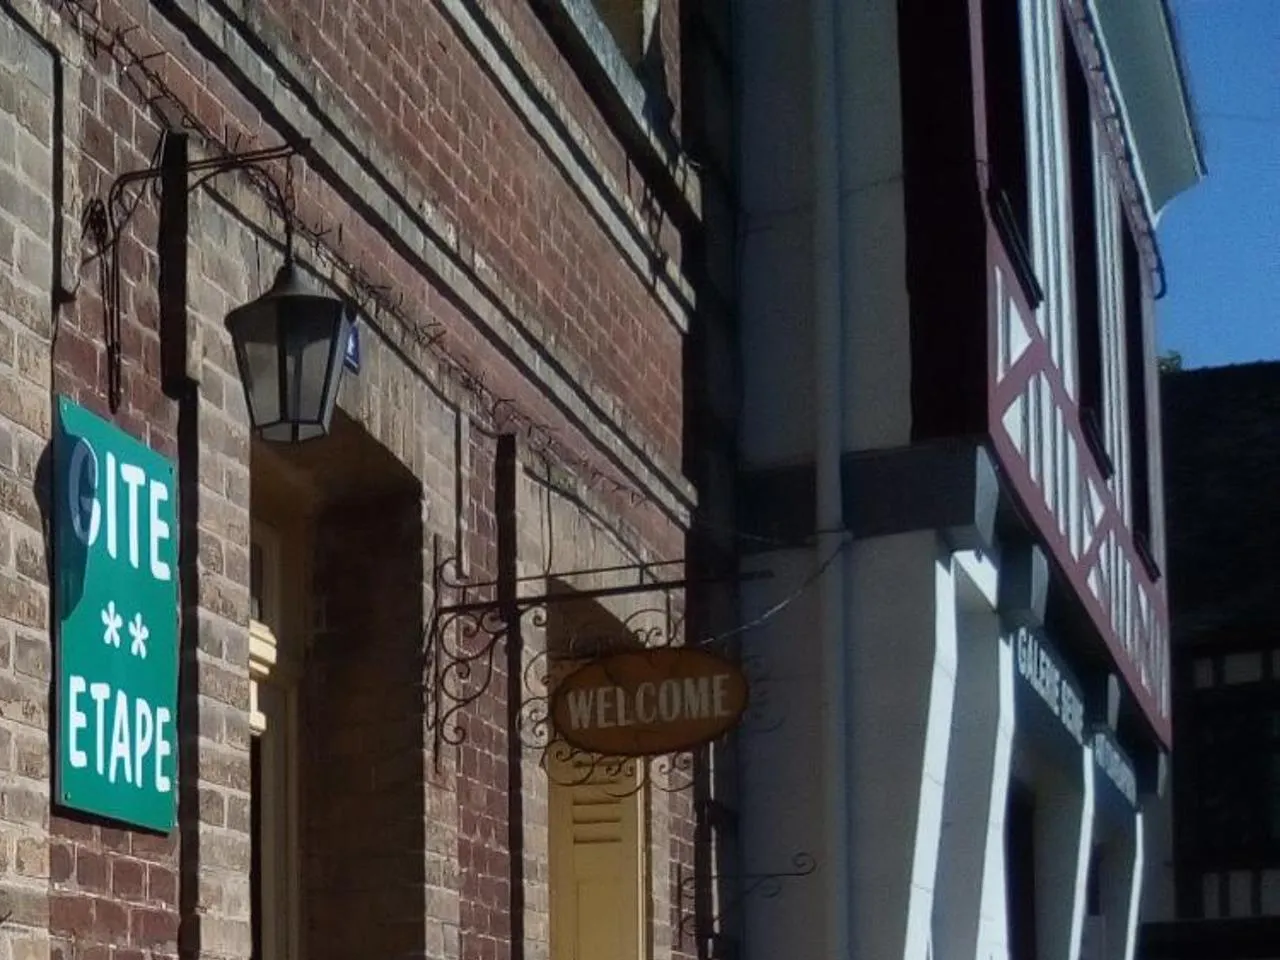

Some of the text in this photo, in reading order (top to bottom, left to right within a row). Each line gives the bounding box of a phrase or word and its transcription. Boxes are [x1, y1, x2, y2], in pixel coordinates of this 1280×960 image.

[68, 436, 171, 581] GITE
[68, 675, 171, 792] ETAPE
[567, 674, 732, 730] WELCOME
